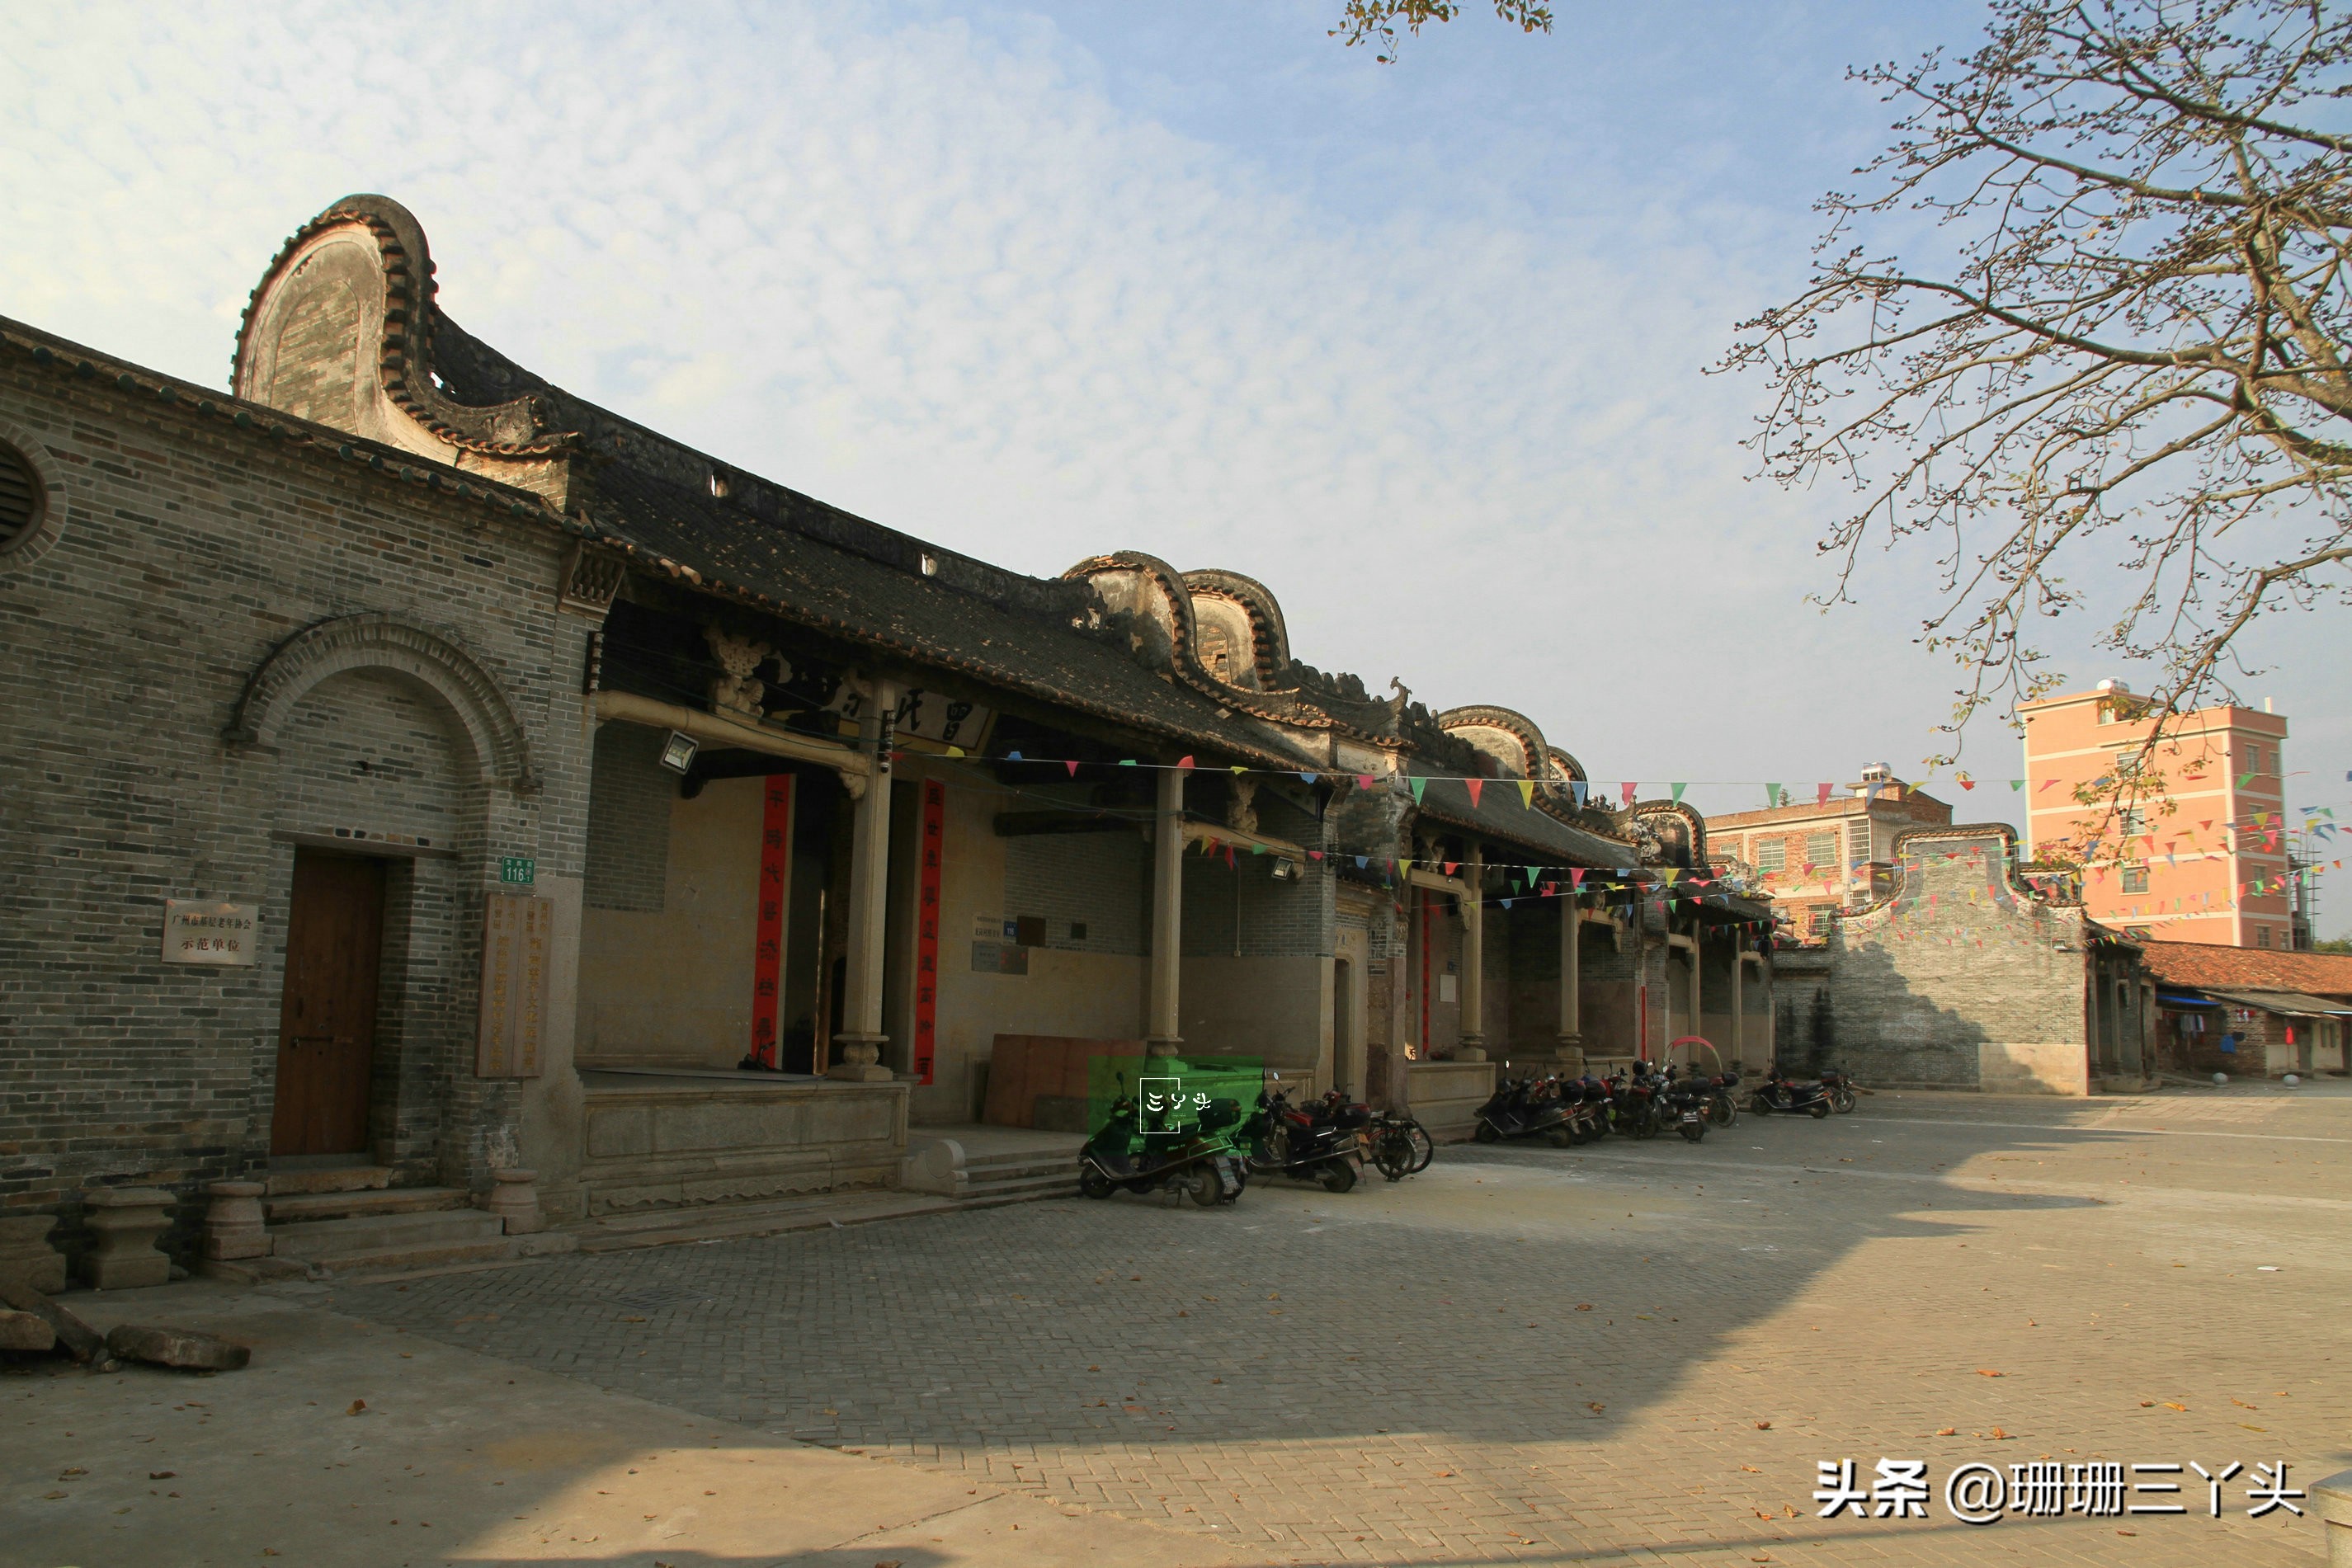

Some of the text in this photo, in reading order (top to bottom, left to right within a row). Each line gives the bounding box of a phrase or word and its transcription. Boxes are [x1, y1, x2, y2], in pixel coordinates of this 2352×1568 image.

[172, 914, 252, 930] 广州市基层老年协会
[181, 937, 240, 952] 示范单位
